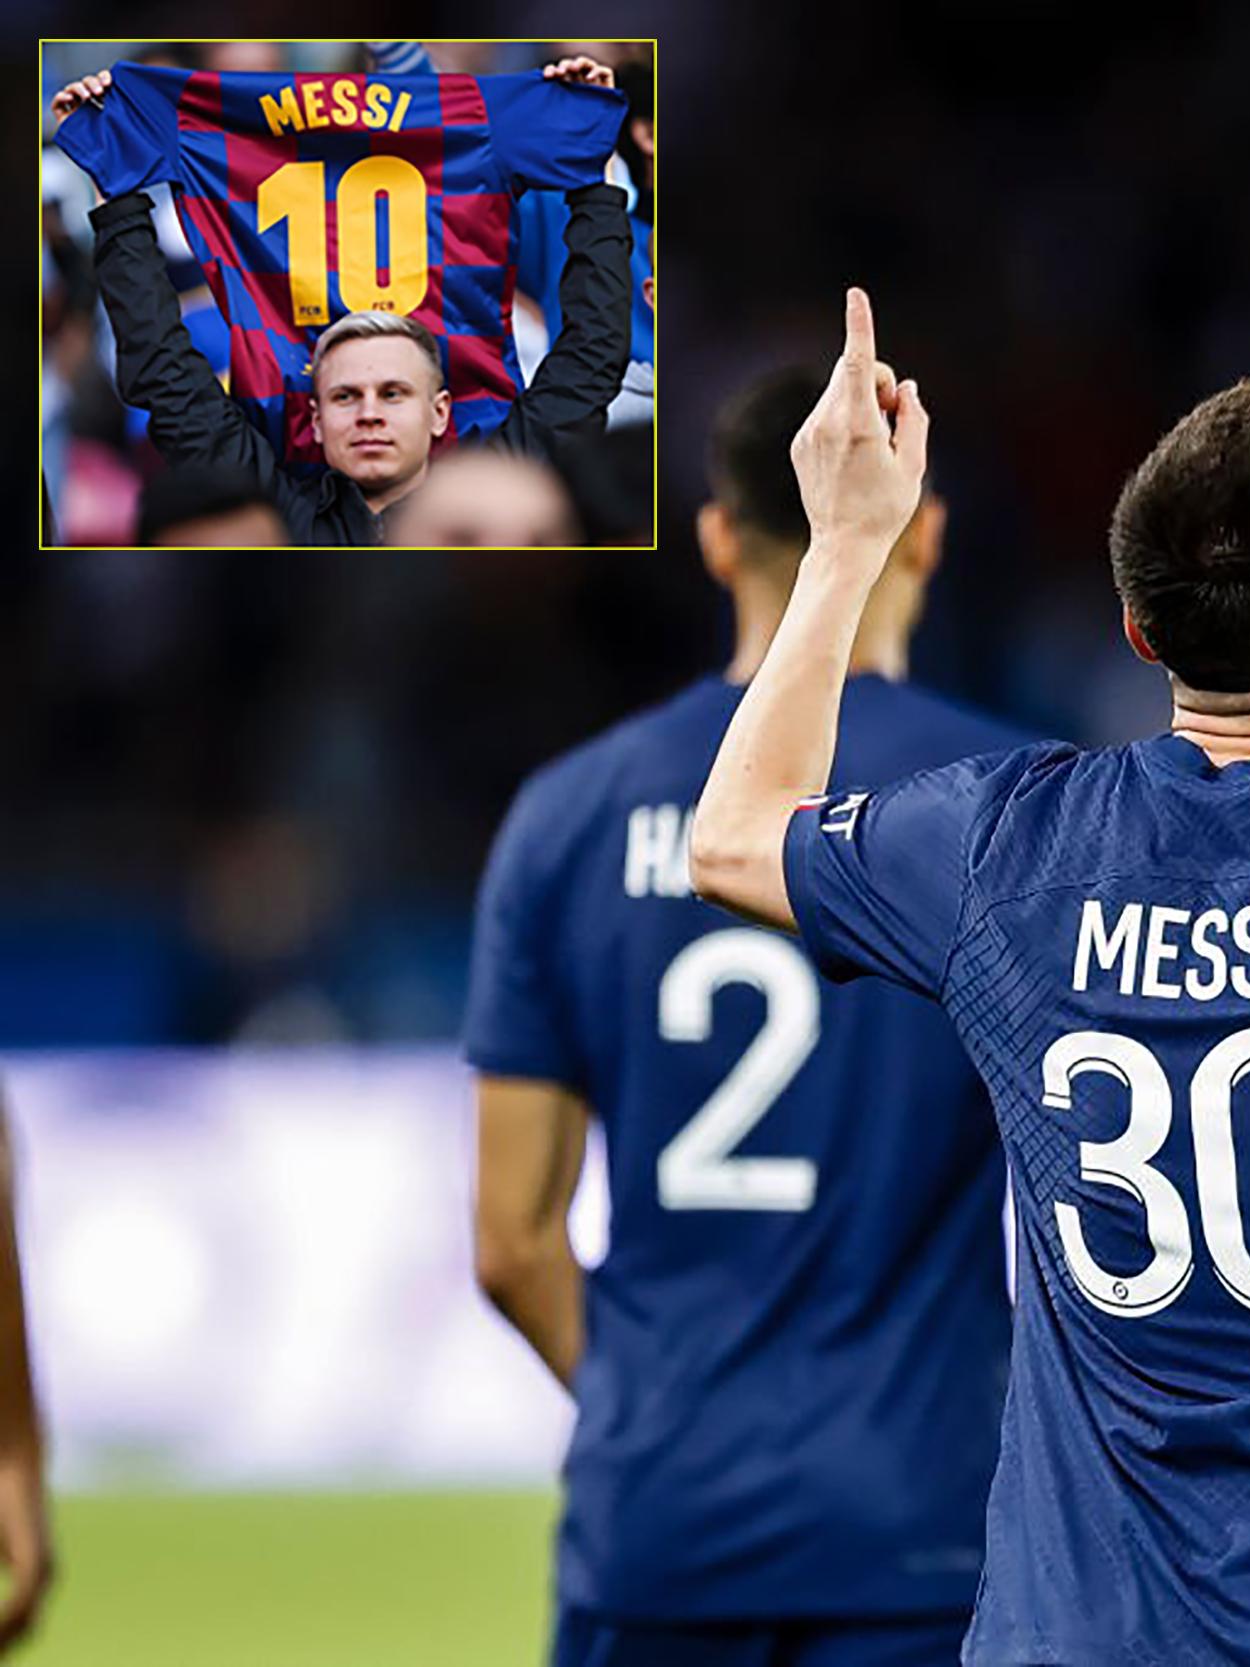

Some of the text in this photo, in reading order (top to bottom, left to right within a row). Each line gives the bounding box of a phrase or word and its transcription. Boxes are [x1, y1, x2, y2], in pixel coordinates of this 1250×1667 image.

[259, 79, 412, 137] MESSI
[257, 155, 428, 326] 10
[657, 926, 820, 1211] 2
